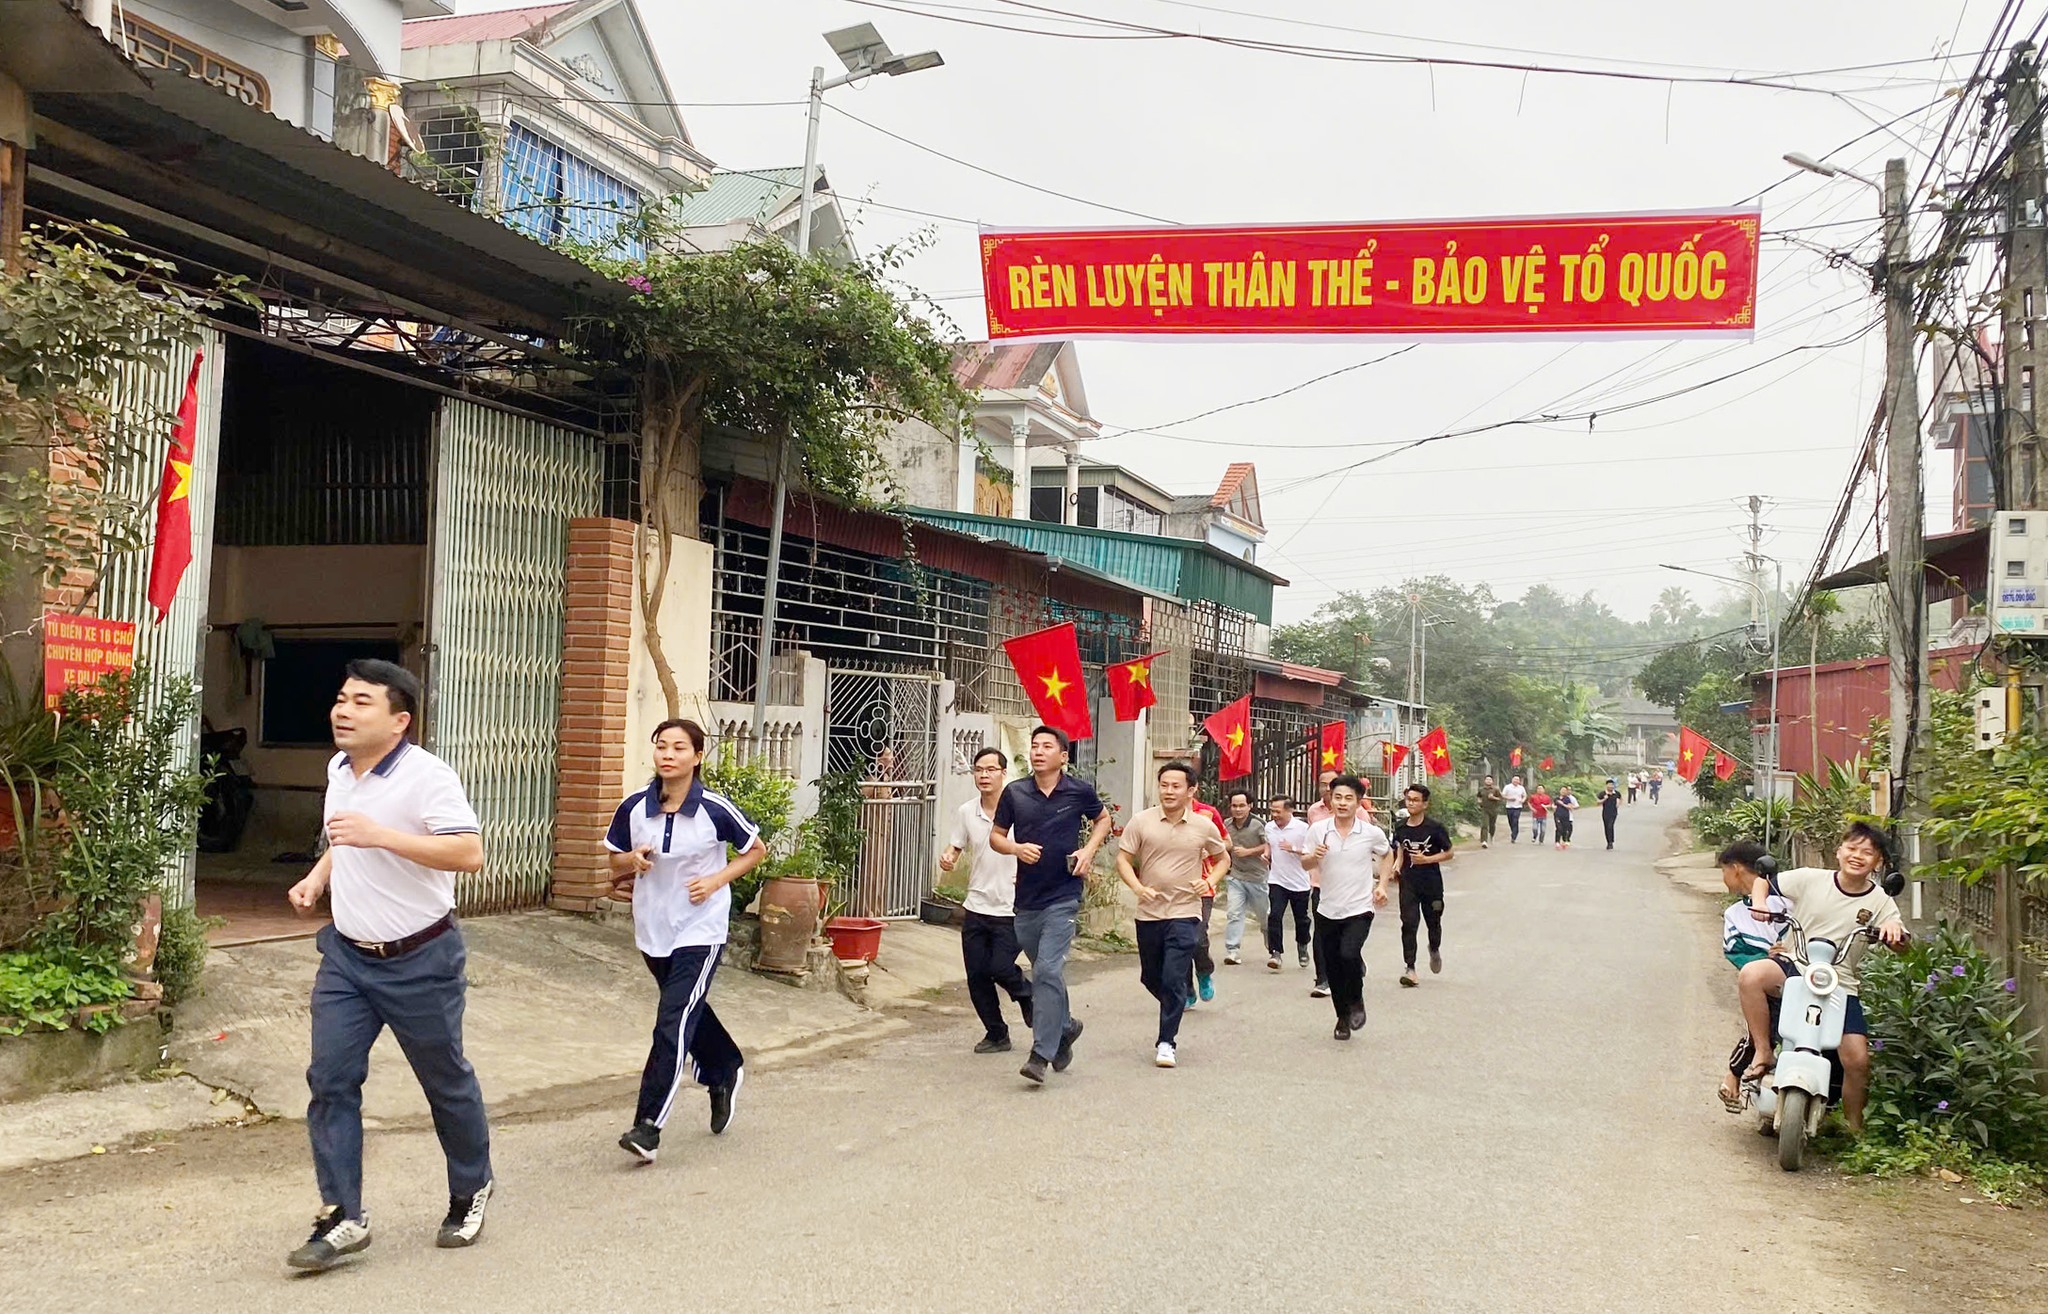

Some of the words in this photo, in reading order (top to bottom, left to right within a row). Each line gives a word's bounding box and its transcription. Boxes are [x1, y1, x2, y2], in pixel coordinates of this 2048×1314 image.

[1008, 254, 1077, 310] RÈN
[1085, 253, 1193, 317] LUYỆN
[1203, 250, 1296, 308] THÂN
[1307, 237, 1375, 307] THỂ
[1412, 239, 1488, 306] BẢO
[1501, 243, 1547, 314] VỆ
[1559, 232, 1611, 303] TỔ
[1618, 233, 1727, 307] QUỐC
[84, 626, 97, 642] XE
[47, 643, 82, 662] CHUYÊN
[84, 647, 103, 666] HỢP
